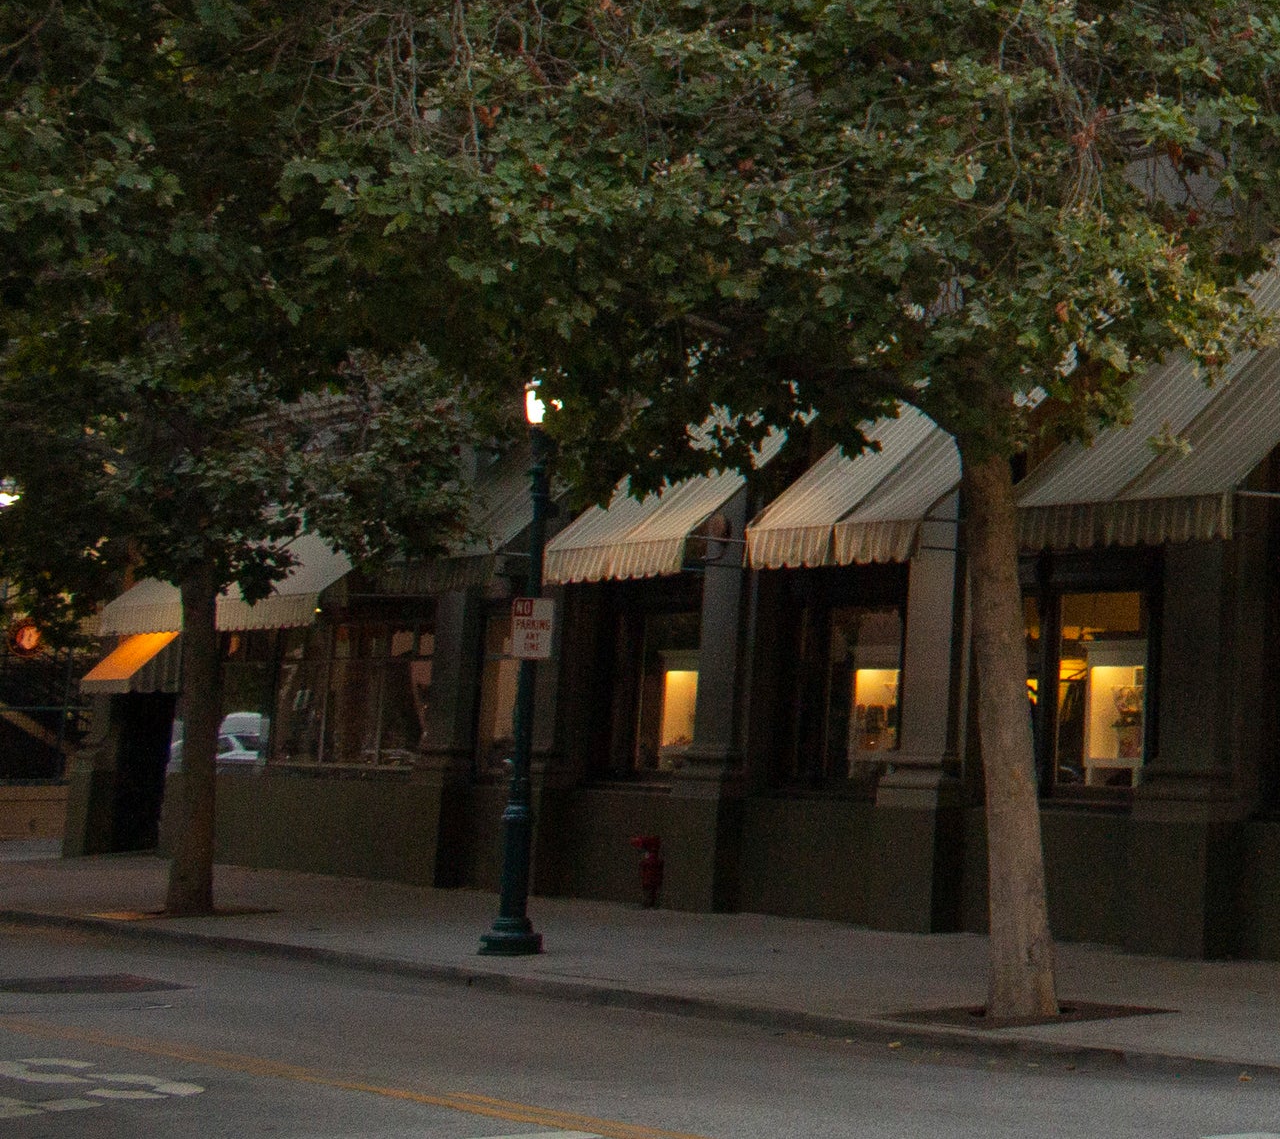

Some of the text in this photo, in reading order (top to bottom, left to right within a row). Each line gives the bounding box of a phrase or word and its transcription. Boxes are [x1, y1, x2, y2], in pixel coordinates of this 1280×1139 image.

[515, 600, 532, 615] NO
[515, 619, 551, 630] PARKING
[525, 632, 540, 640] ANY
